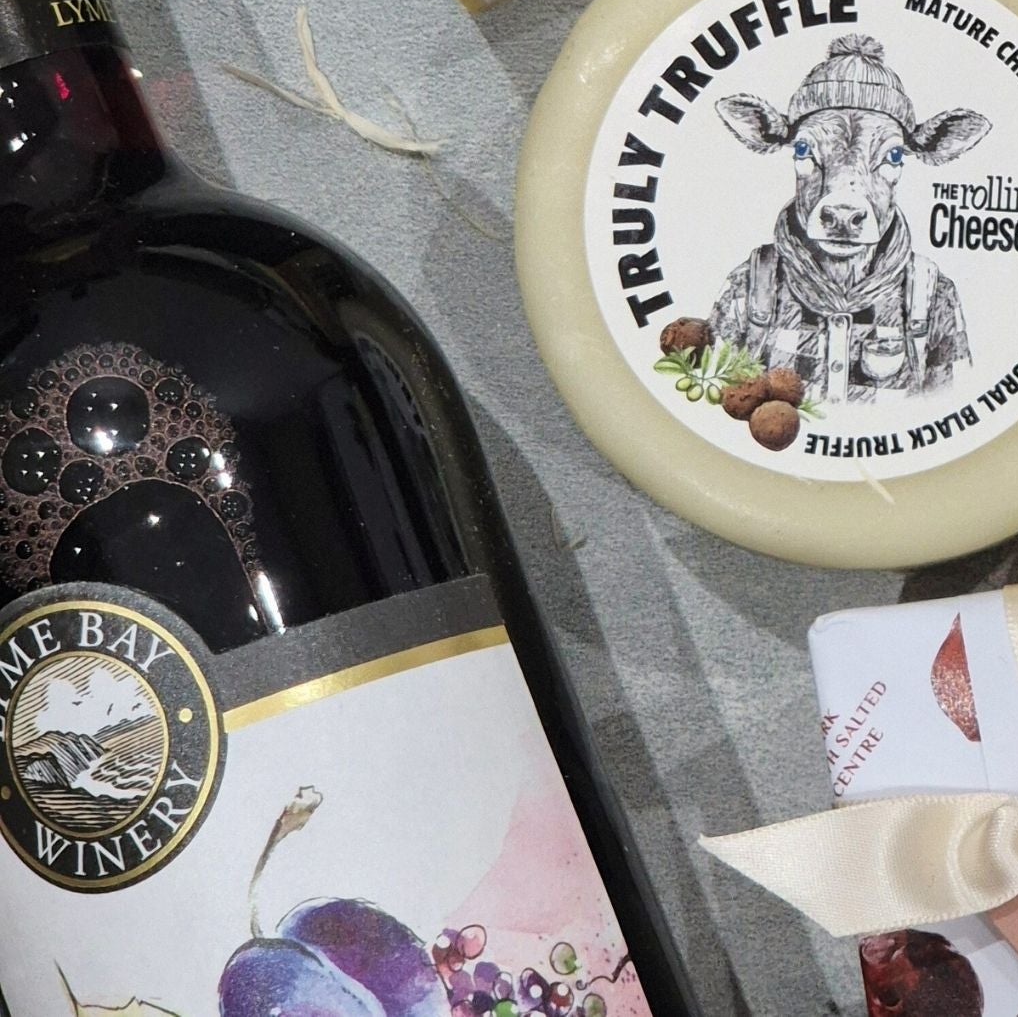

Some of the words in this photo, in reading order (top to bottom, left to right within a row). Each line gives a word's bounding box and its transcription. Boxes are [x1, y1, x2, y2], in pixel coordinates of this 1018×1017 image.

[932, 182, 959, 200] THE
[612, 132, 673, 329] TRULY
[804, 430, 905, 459] TRUFFLE
[909, 402, 981, 451] BLACK
[79, 612, 176, 673] BAY
[835, 680, 887, 748] SALTED
[833, 726, 884, 797] CENTRE
[34, 760, 203, 877] WINERY
